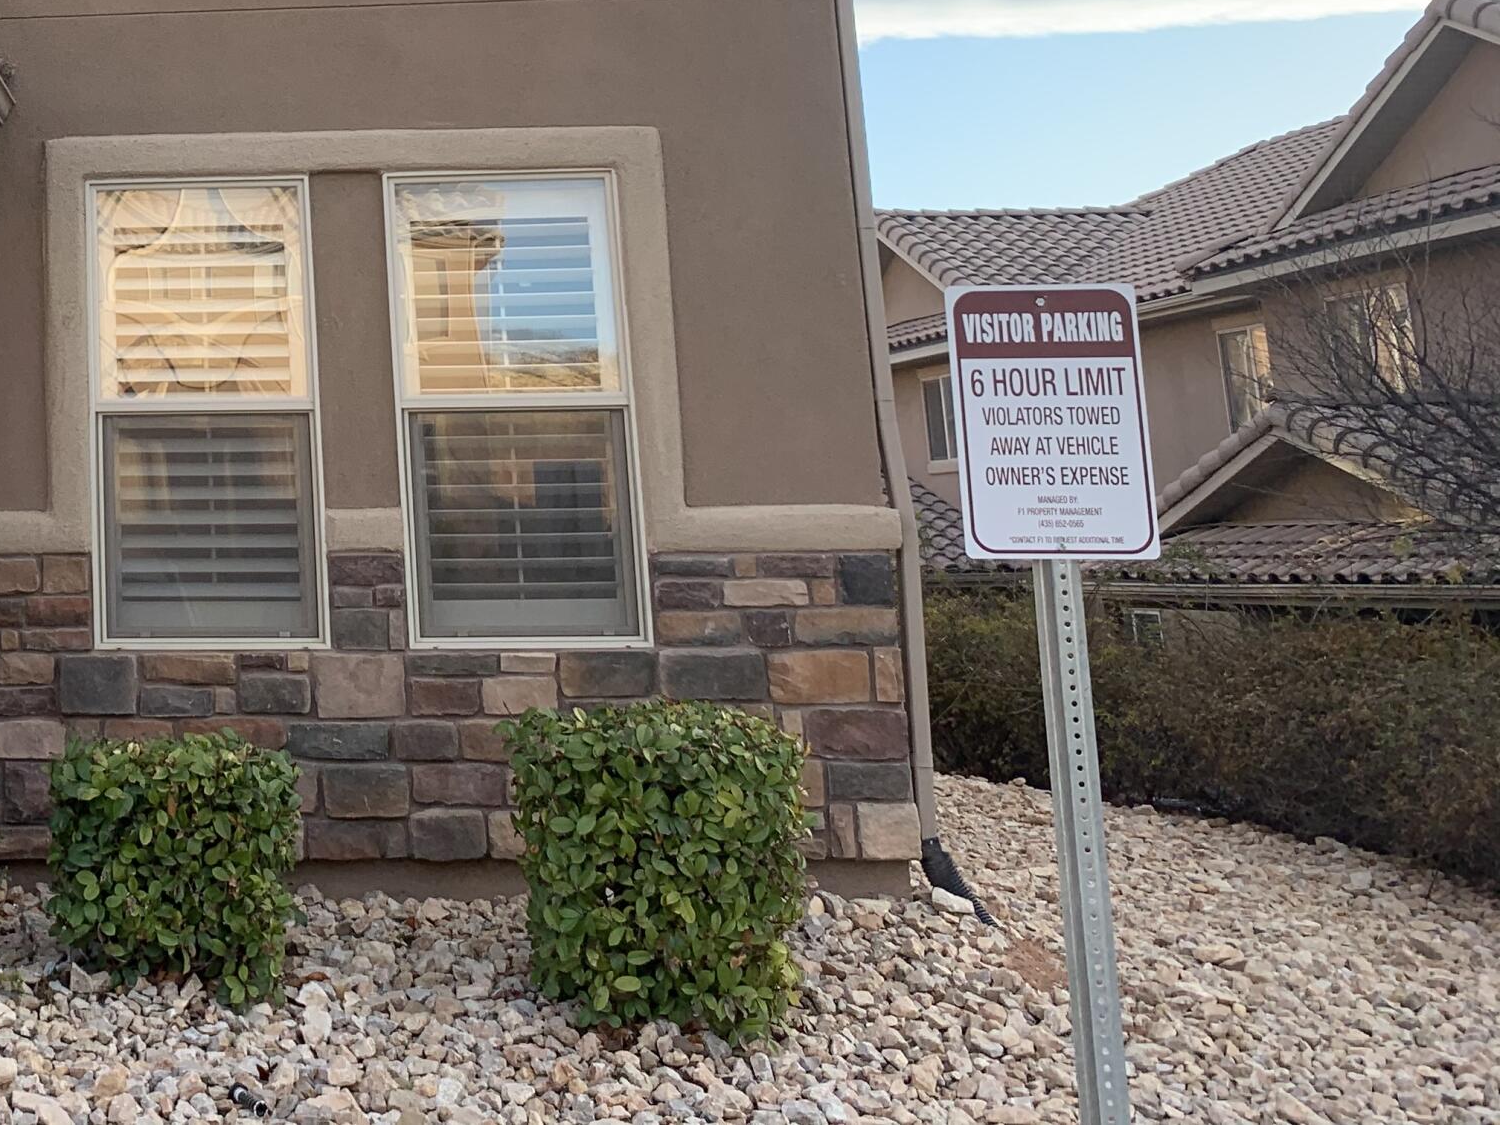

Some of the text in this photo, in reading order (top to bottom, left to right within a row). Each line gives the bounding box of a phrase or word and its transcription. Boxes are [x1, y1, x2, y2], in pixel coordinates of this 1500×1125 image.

[962, 311, 1125, 344] VISITOR PARKING
[970, 367, 1126, 398] 6 HOUR LIMIT
[982, 406, 1121, 426] VIOLATORS TOWED
[990, 436, 1119, 455] AWAY AT VEHICLE
[985, 466, 1130, 486] OWNER'S EXPENSE
[1037, 495, 1067, 504] MANAGED
[1026, 507, 1058, 516] PROPERTY
[1059, 507, 1103, 516] MANAGEMENT
[1111, 536, 1125, 544] TIME
